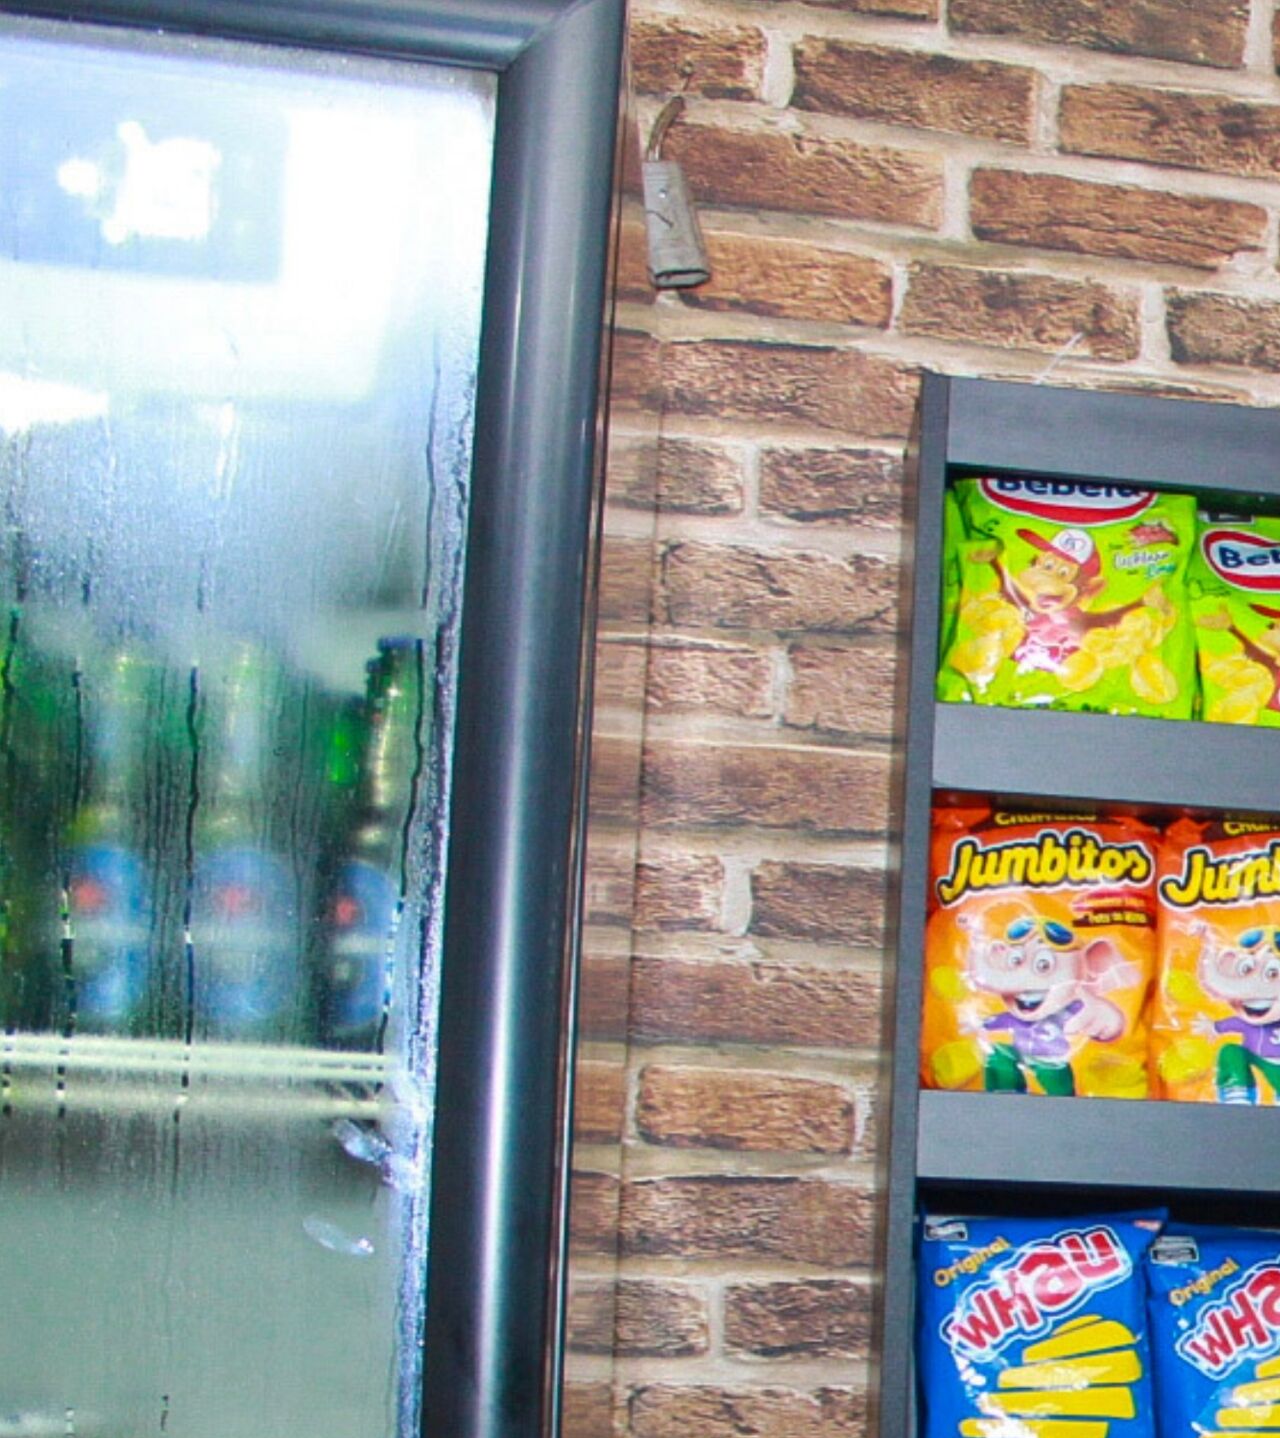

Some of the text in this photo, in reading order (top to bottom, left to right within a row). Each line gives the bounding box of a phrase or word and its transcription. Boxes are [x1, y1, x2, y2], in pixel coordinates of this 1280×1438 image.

[939, 829, 1152, 904] Jumbitos
[934, 1237, 1012, 1288] Original
[1168, 1257, 1241, 1308] Original
